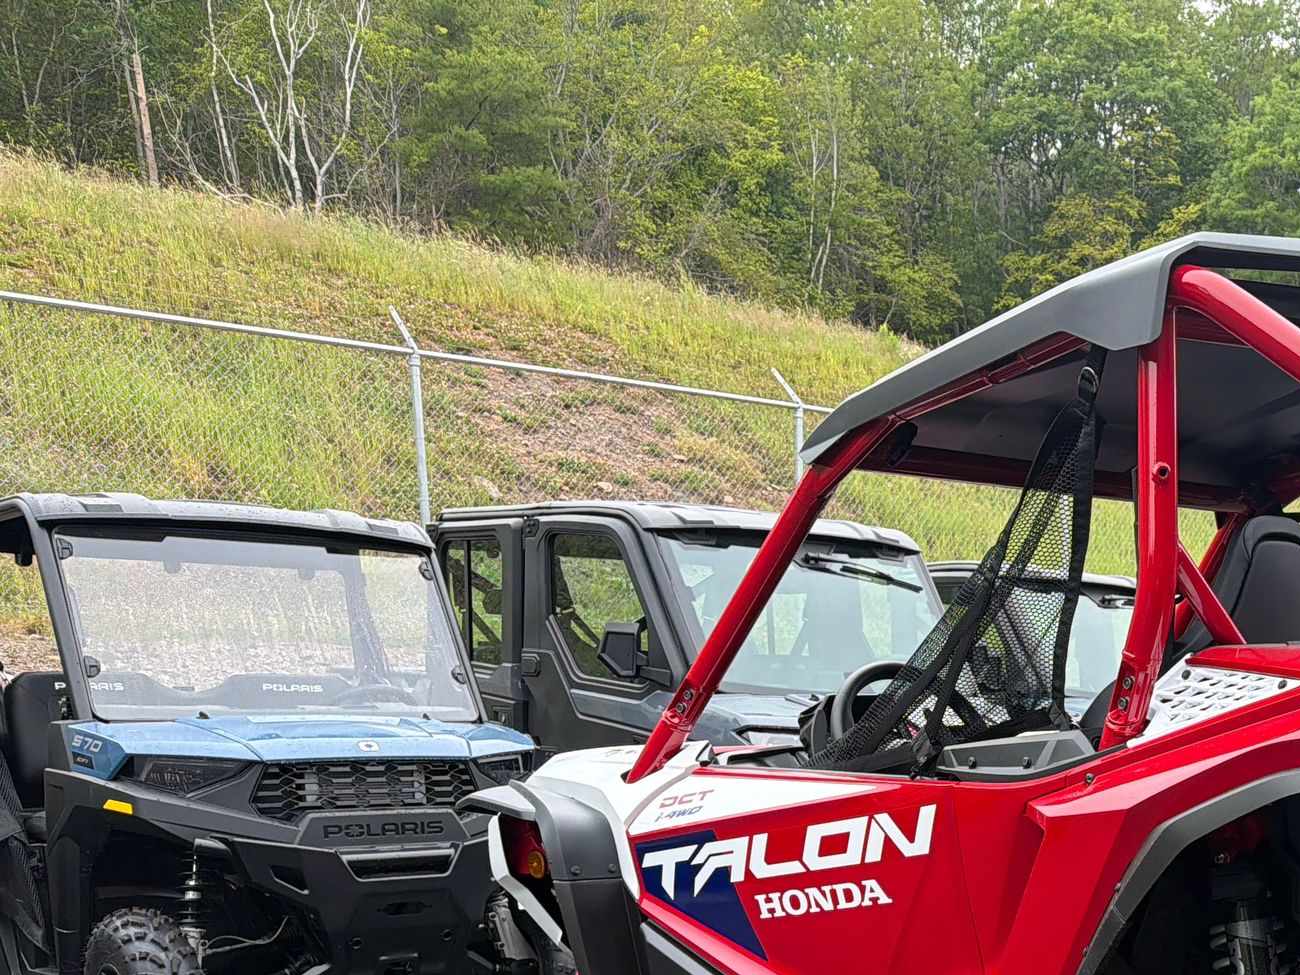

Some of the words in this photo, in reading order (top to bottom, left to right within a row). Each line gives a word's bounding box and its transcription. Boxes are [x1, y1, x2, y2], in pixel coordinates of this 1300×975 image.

[54, 682, 124, 691] PARIS
[262, 683, 324, 693] POLARIS
[72, 735, 103, 753] 570
[659, 789, 715, 809] DCT
[322, 820, 445, 839] POLARIS
[641, 804, 937, 901] TALON
[754, 879, 893, 919] HONDA
